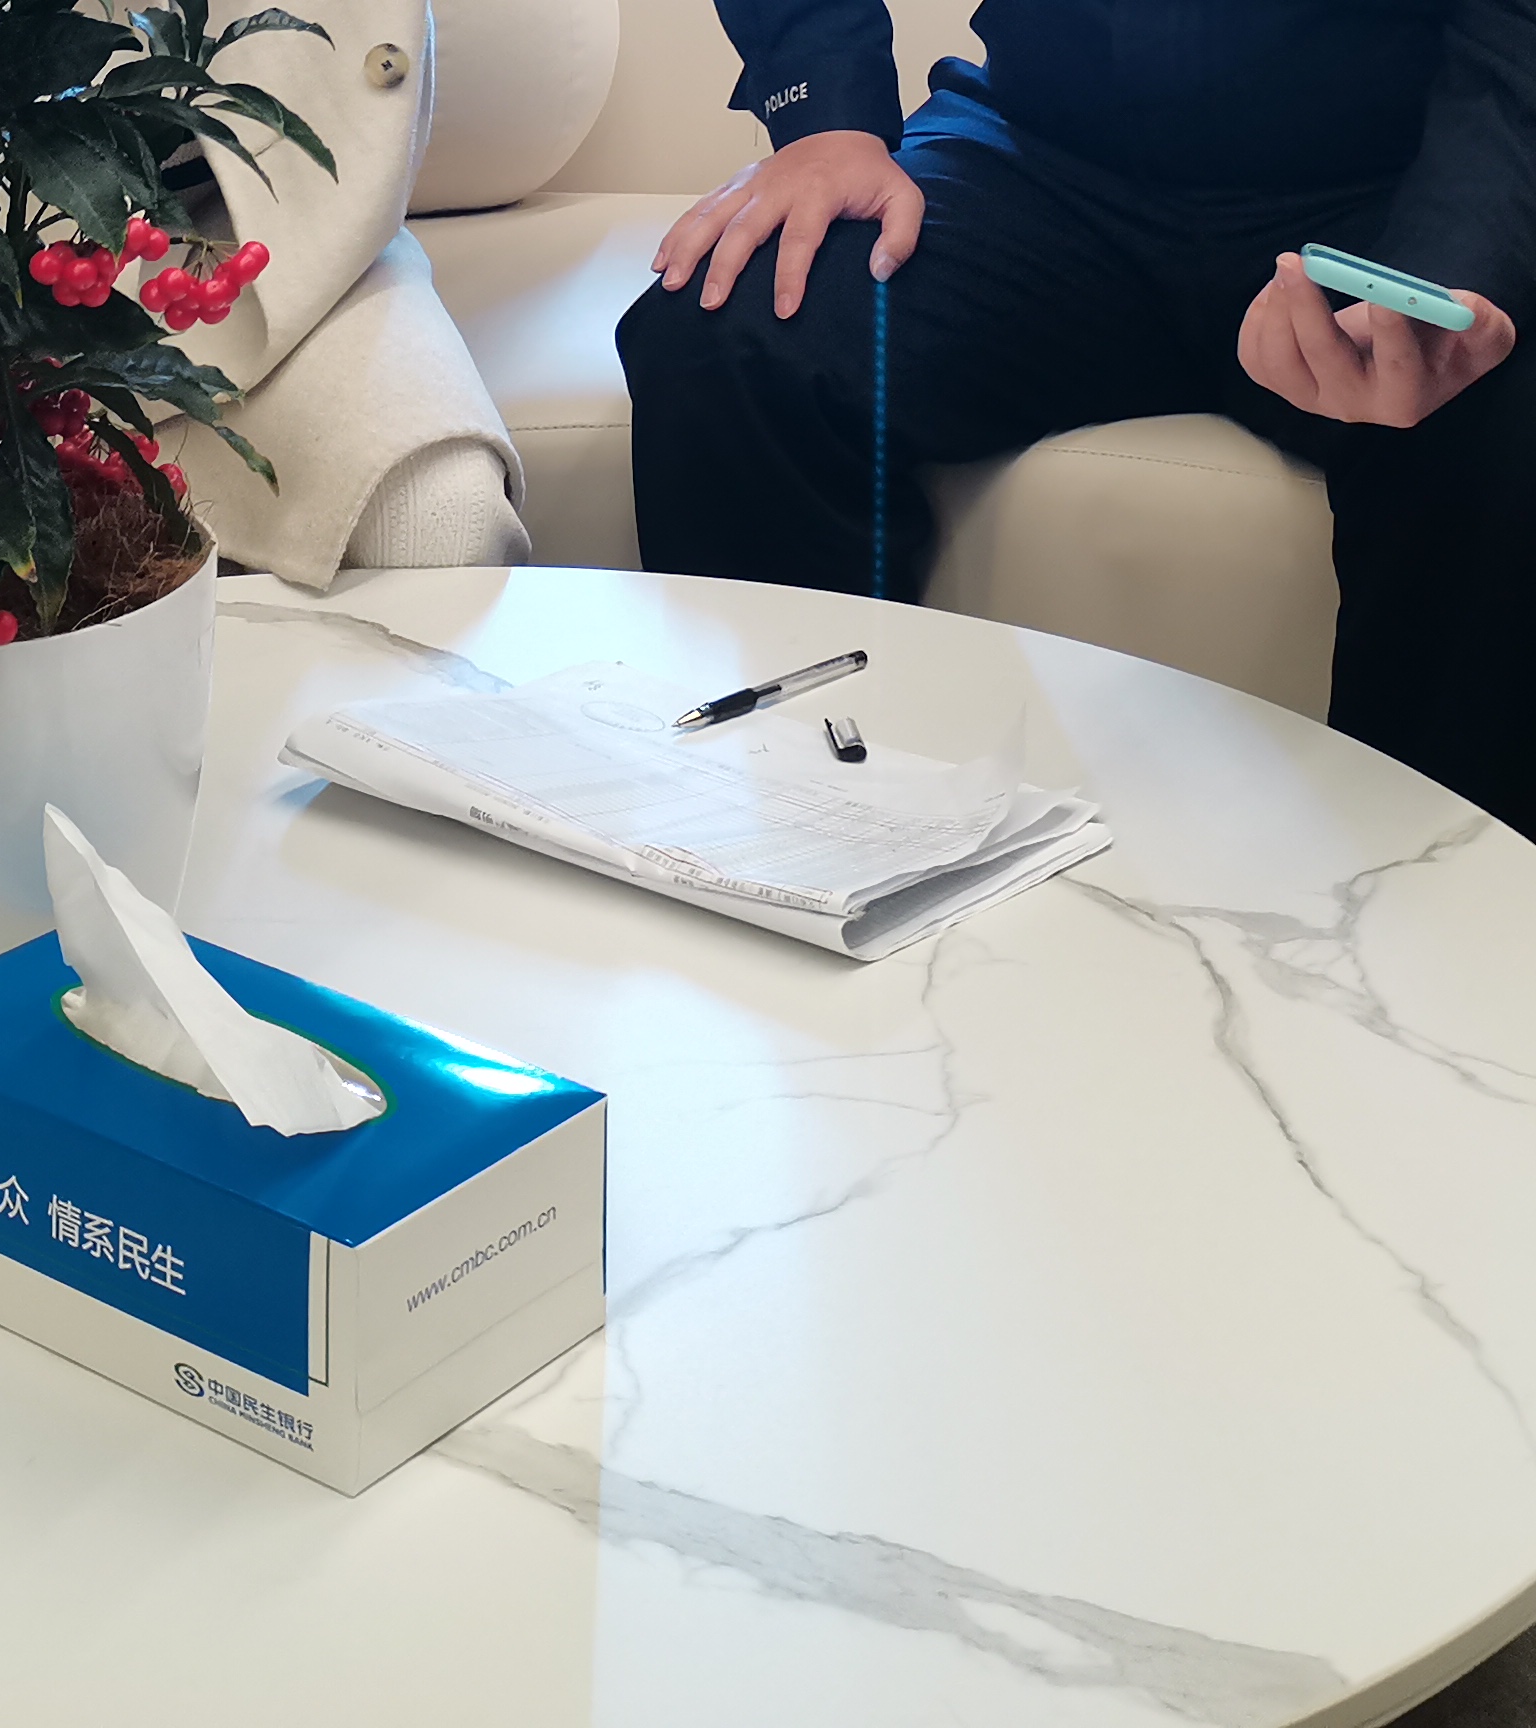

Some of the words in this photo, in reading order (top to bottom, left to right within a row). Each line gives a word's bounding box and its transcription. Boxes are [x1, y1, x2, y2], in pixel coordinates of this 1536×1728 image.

[764, 81, 808, 119] POLICE
[48, 1194, 186, 1295] 情系民生
[406, 1206, 557, 1312] www.cmbc.com.cn
[207, 1378, 314, 1440] 中国民生银行
[208, 1395, 237, 1416] CHINA
[287, 1432, 314, 1452] BANK
